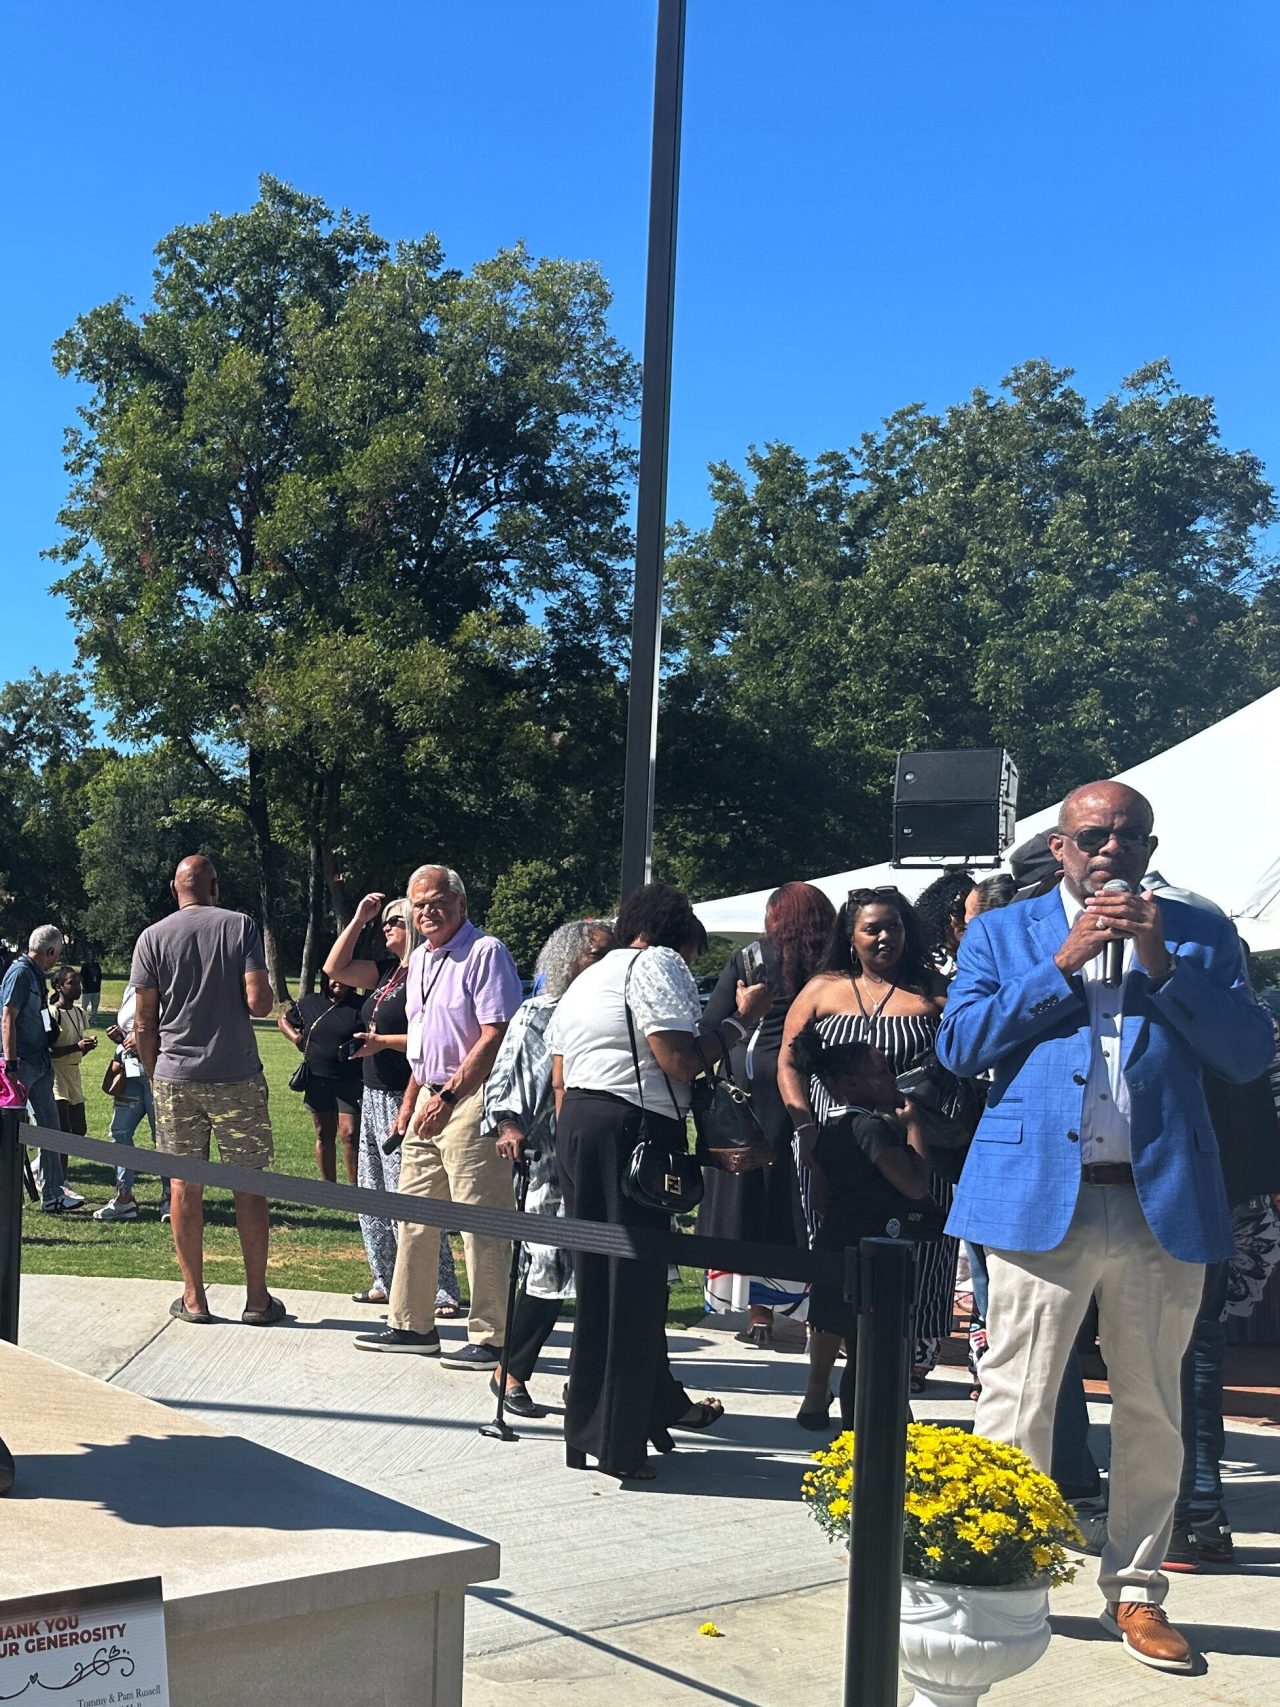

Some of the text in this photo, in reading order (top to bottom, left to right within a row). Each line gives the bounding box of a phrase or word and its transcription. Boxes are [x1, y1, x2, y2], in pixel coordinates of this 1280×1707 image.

[43, 1615, 80, 1634] YOU
[24, 1623, 127, 1653] GENEROSITY
[108, 1693, 116, 1704] &
[117, 1691, 134, 1702] Pam
[135, 1684, 161, 1699] Russell
